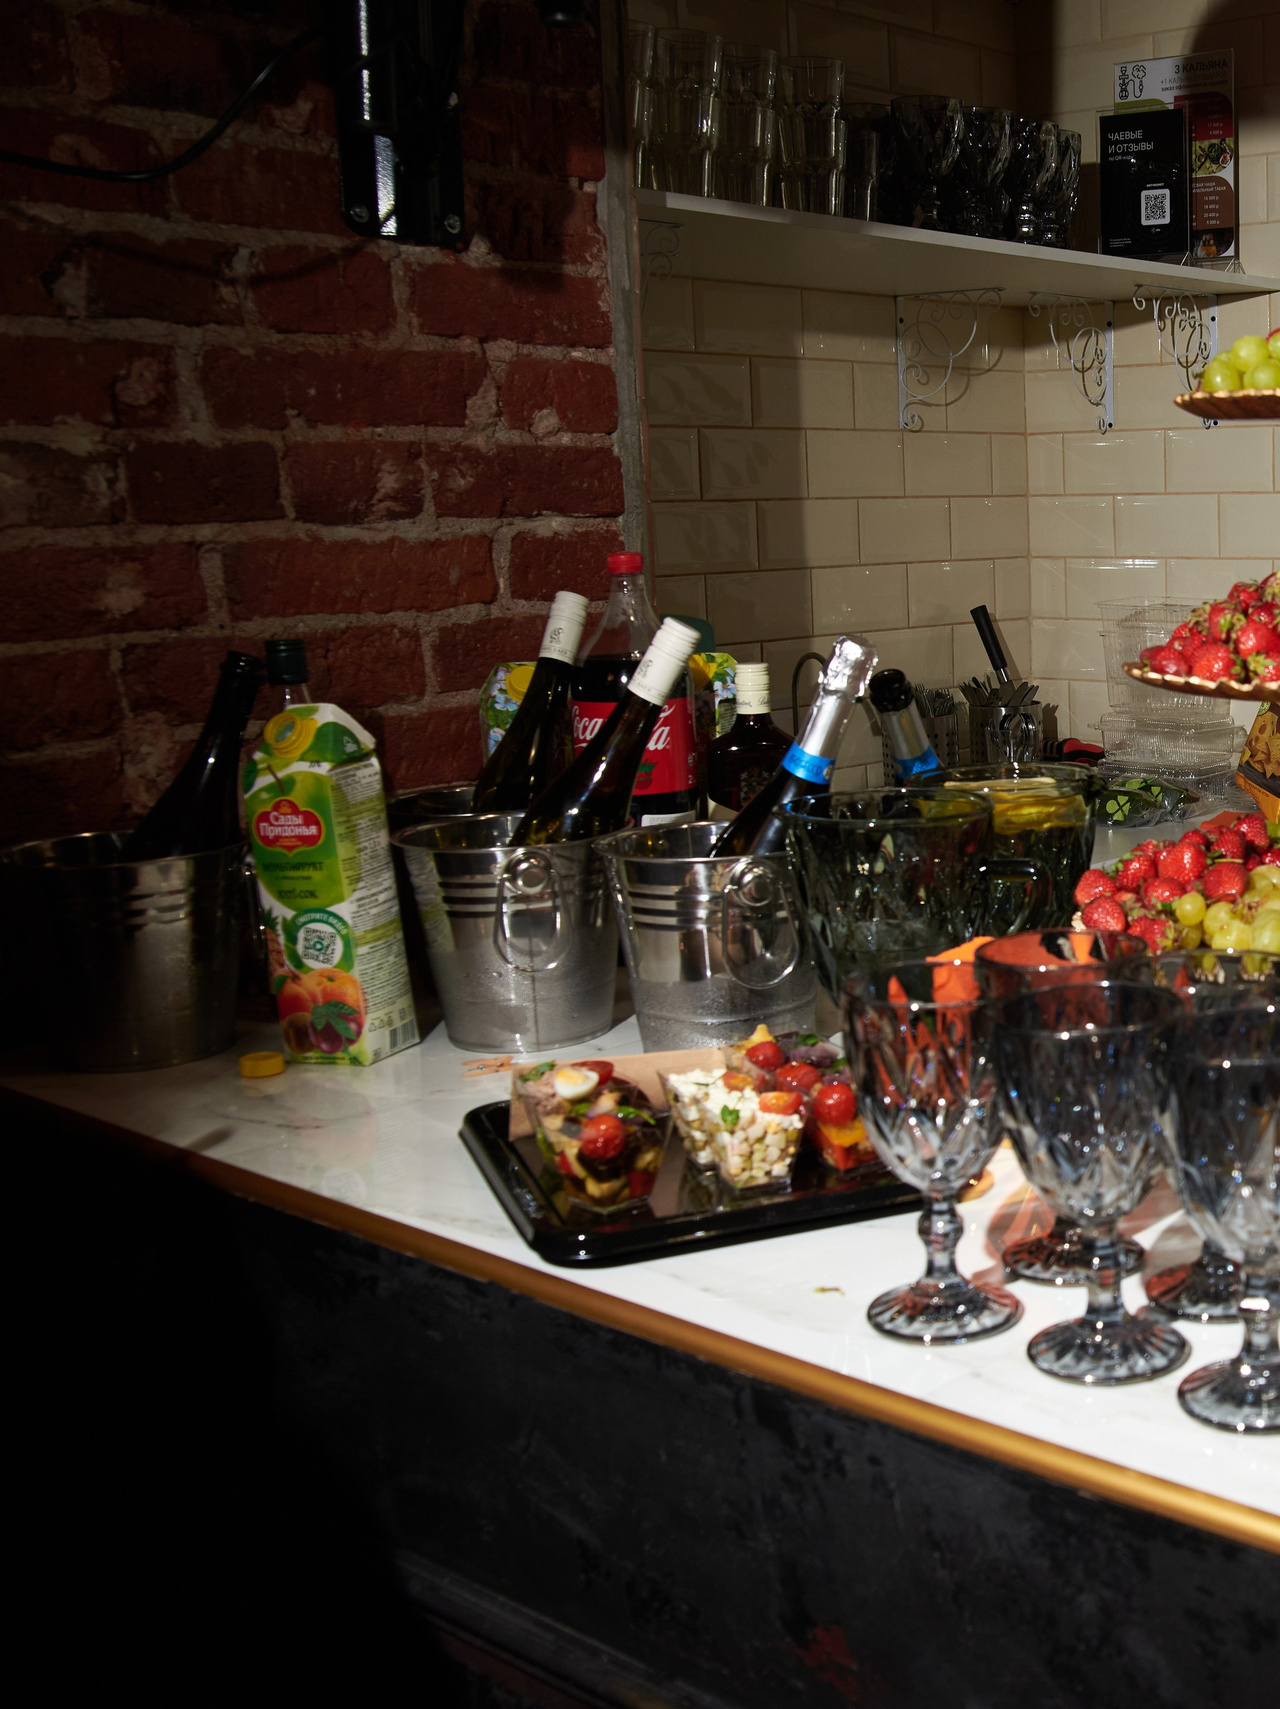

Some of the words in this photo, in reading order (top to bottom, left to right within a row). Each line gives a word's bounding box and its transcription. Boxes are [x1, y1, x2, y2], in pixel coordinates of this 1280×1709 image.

[1174, 64, 1180, 74] 3
[1182, 58, 1228, 73] КАЛЬЯНА
[1108, 129, 1143, 141] ЧАЕВЫЕ
[1108, 145, 1115, 154] И
[1116, 141, 1154, 153] ОТЗЫВЫ
[269, 811, 304, 826] Сады
[259, 822, 318, 839] Придонья
[295, 912, 328, 925] СМОТРИТЕ
